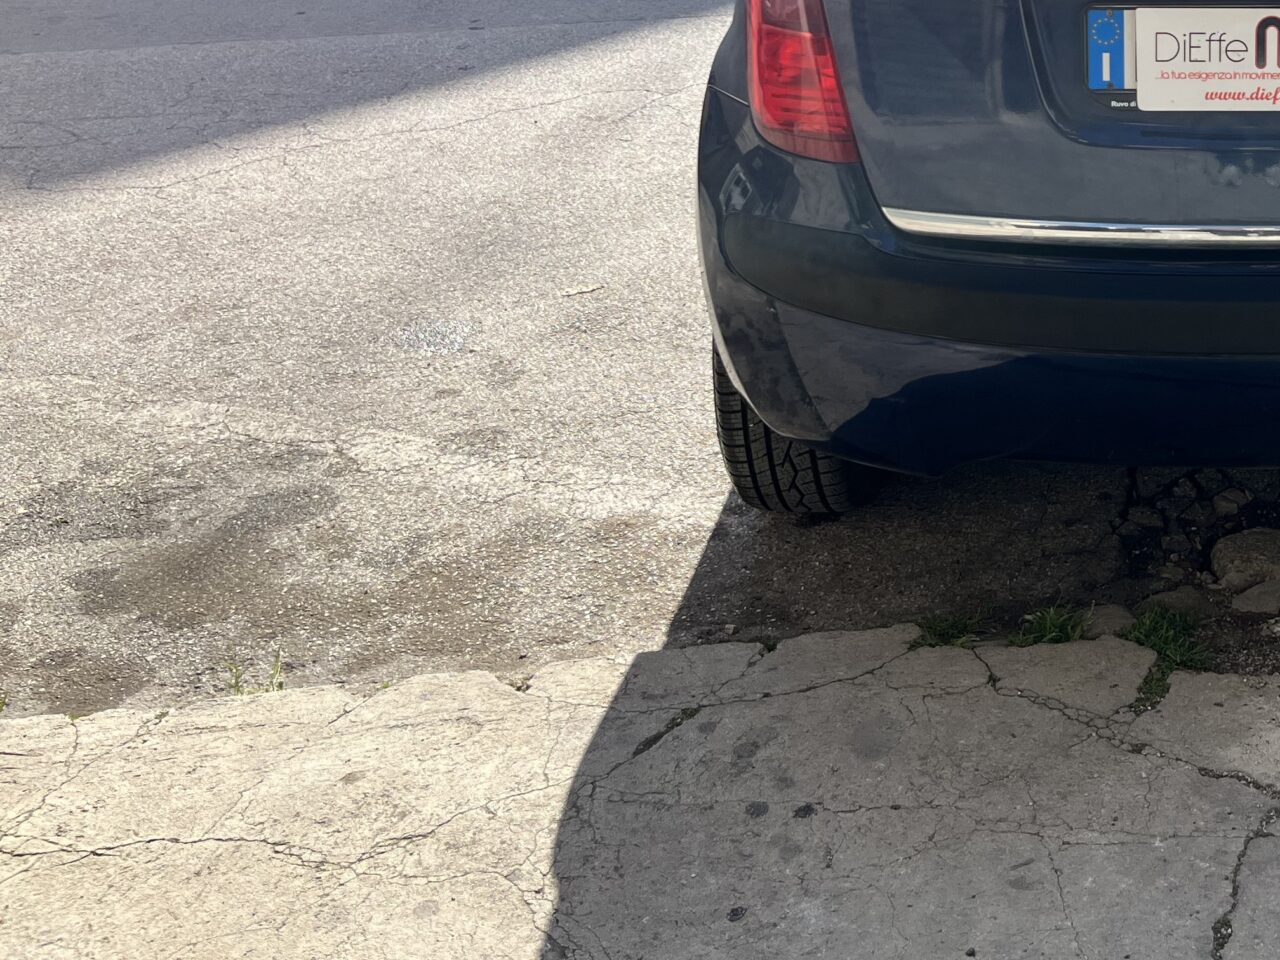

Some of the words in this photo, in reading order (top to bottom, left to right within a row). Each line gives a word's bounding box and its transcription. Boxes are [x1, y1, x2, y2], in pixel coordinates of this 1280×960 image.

[1154, 31, 1249, 63] DiEffe
[1171, 71, 1187, 80] tua
[1187, 71, 1232, 82] esigenza
